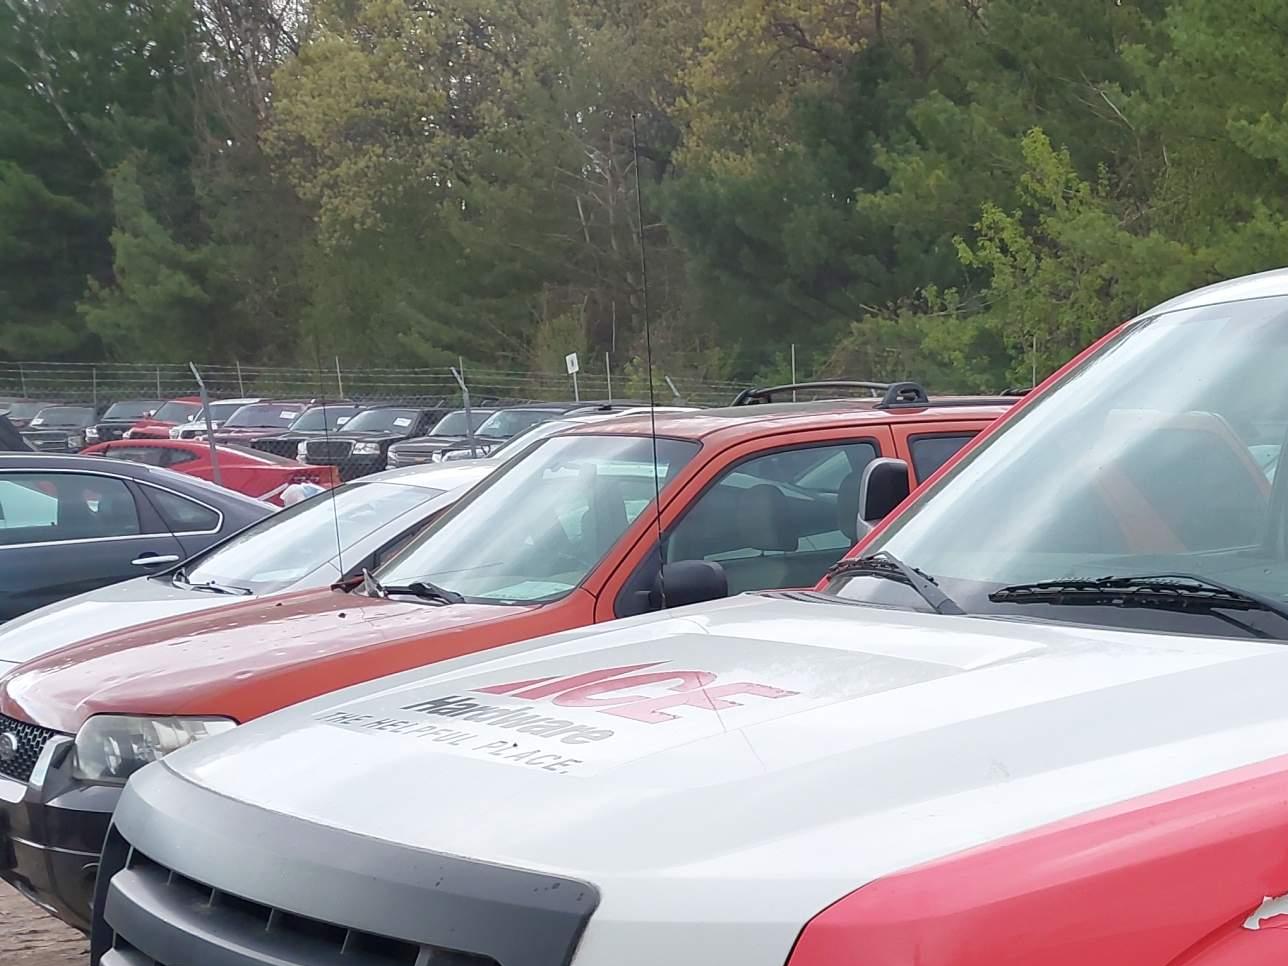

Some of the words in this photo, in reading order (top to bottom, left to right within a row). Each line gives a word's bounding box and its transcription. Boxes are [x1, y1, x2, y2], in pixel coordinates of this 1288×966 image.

[469, 660, 800, 724] ACE
[314, 711, 374, 724] THE
[360, 718, 479, 746] HELPFUL
[400, 695, 615, 744] Hardware
